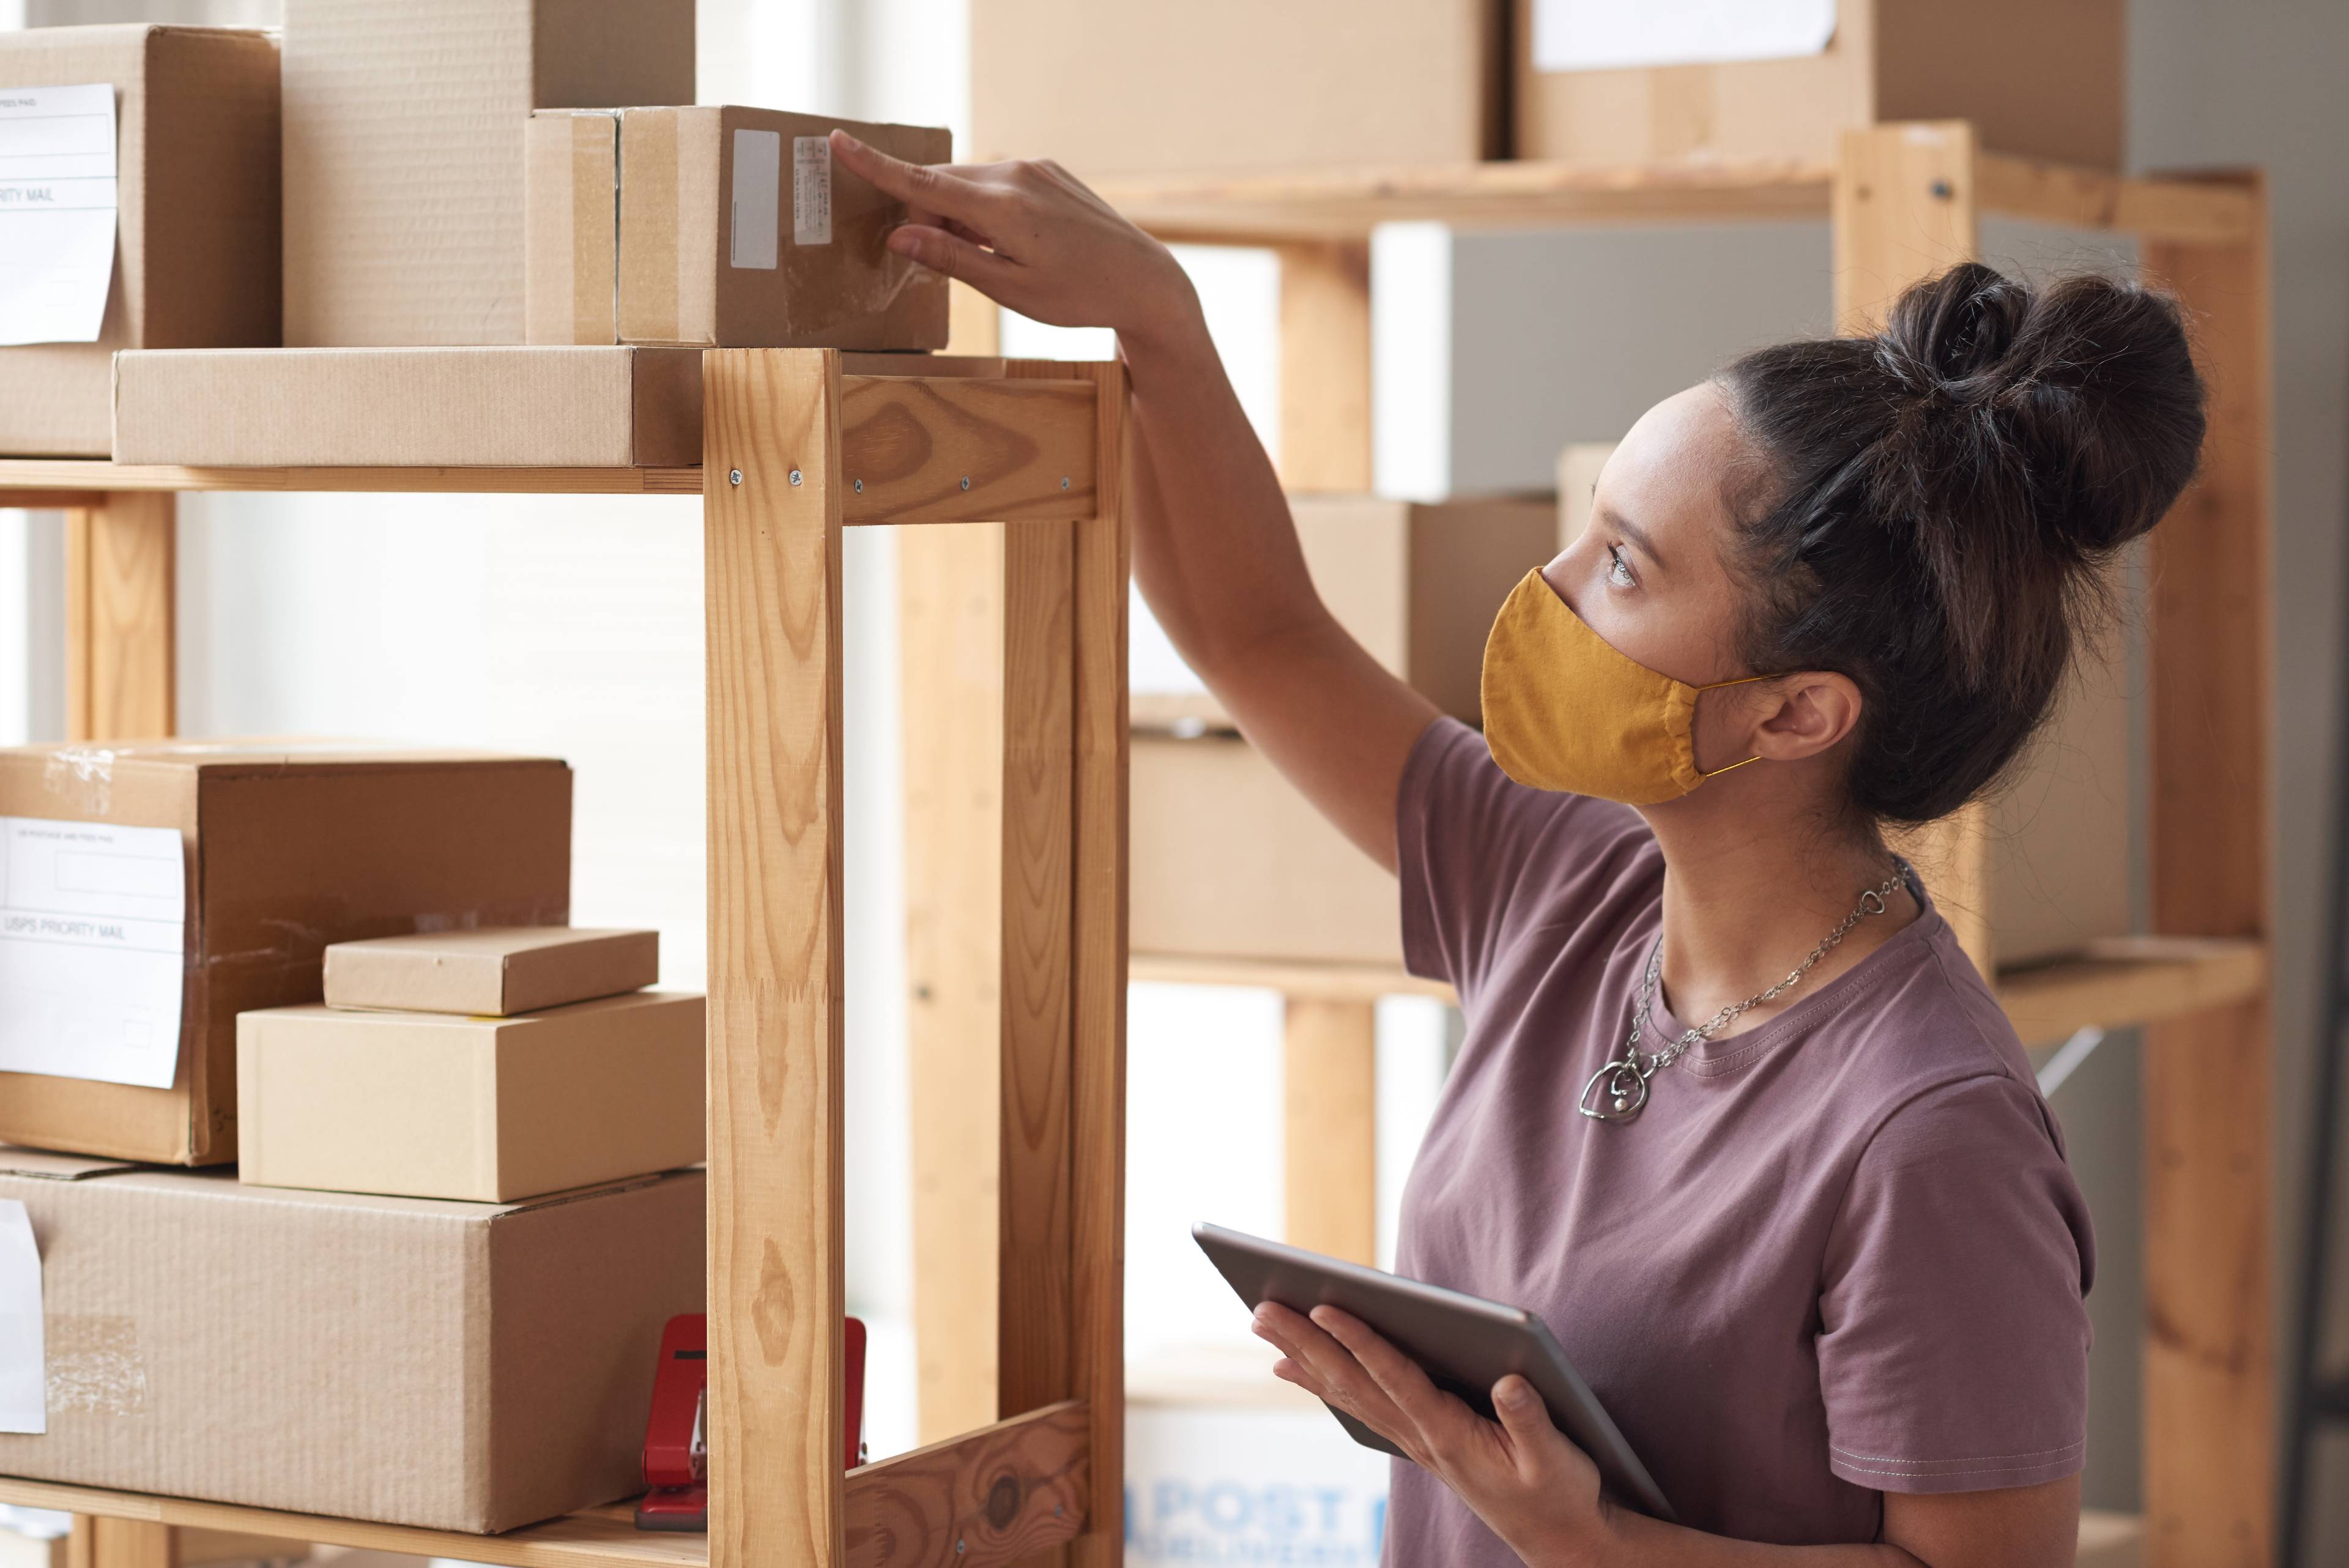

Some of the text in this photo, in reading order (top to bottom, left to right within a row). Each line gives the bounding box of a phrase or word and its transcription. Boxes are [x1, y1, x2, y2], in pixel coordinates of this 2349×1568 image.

[26, 187, 54, 201] MAIL
[4, 916, 126, 940] USPS PRIORITY MAIL
